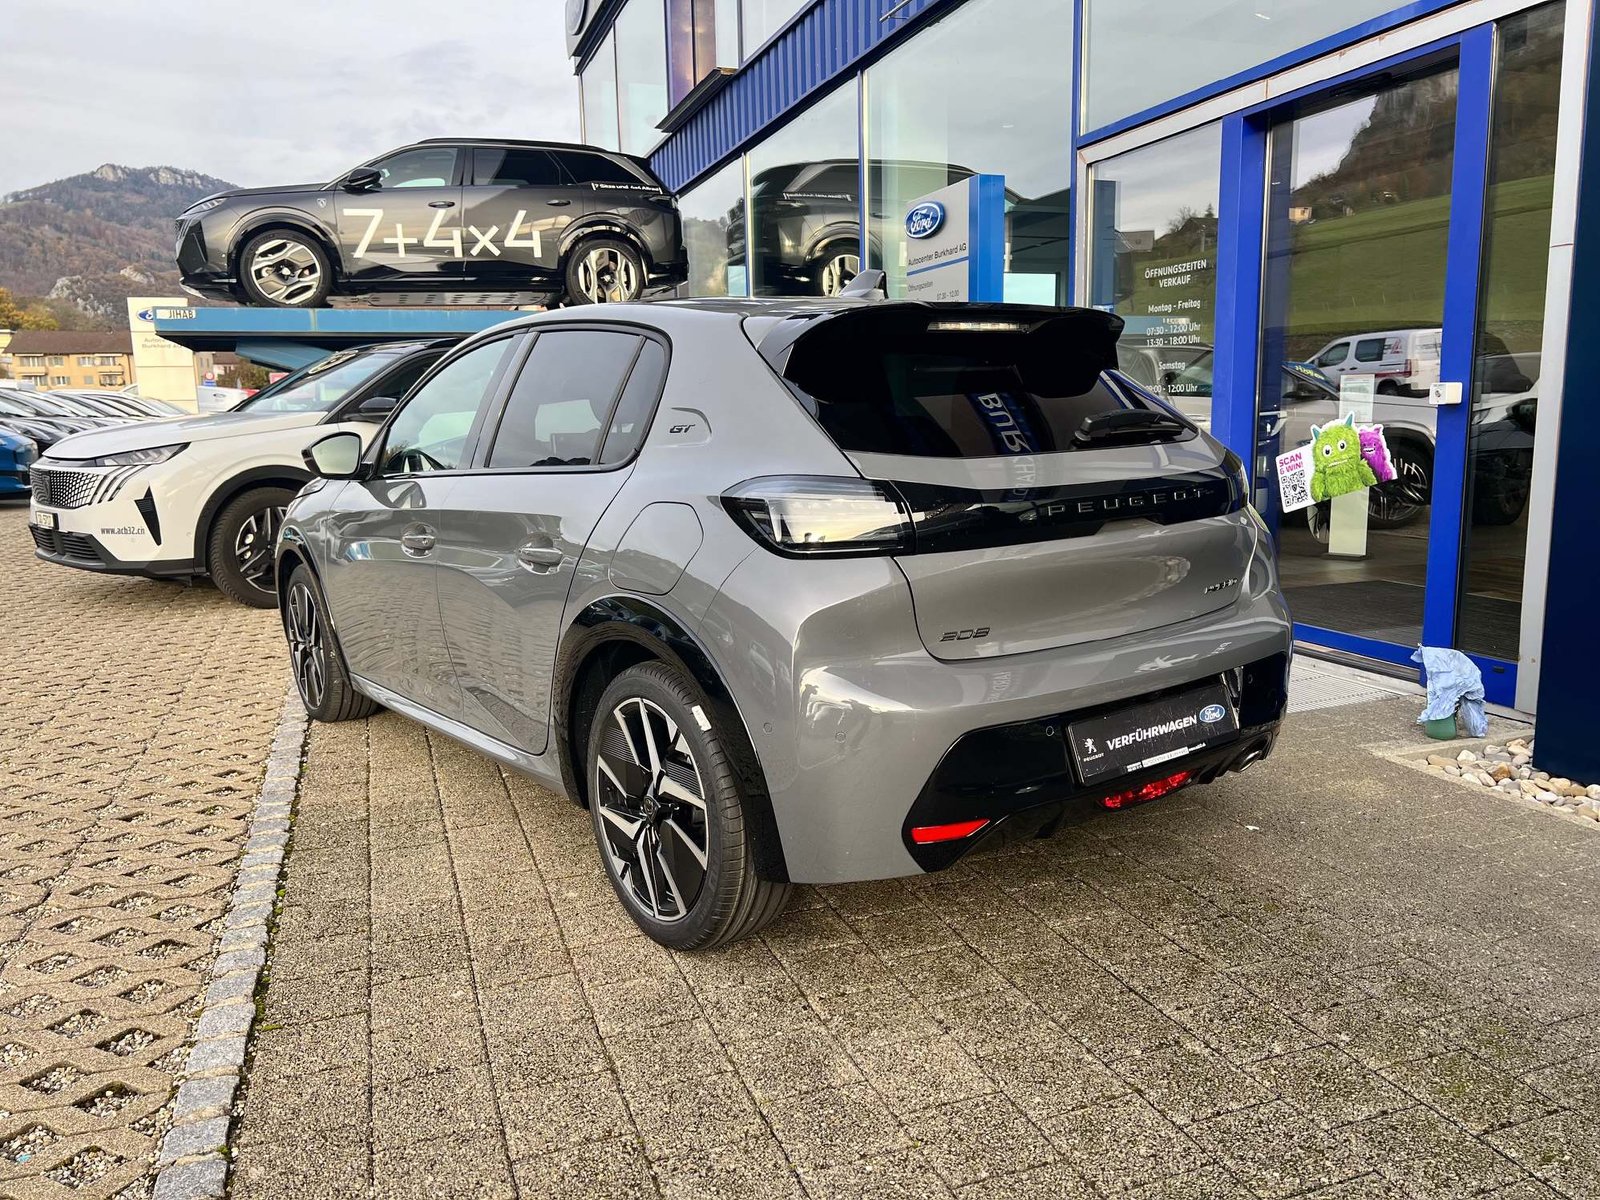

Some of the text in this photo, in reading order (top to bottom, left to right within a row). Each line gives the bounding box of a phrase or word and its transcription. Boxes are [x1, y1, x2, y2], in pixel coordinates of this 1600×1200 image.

[908, 242, 967, 266] Autocenter Burkhard AG
[1145, 259, 1207, 279] ÖFFNUNGSZEITEN
[1159, 275, 1191, 288] VERKAUF
[1148, 304, 1172, 313] Montag
[1178, 299, 1201, 309] Freitag
[1146, 327, 1164, 336] 07:30
[1189, 322, 1201, 331] Uhr
[1146, 338, 1163, 347] 13:30
[1169, 336, 1187, 345] 18:00
[1188, 335, 1200, 344] Uhr
[1158, 361, 1186, 370] Samstag
[1167, 384, 1184, 393] 12:00
[1185, 383, 1198, 392] Uhr
[670, 424, 696, 433] GT
[1279, 453, 1302, 467] SCAN
[1285, 462, 1304, 473] WIN!
[1048, 485, 1206, 516] PEUGEOT
[940, 627, 990, 642] 208
[1106, 714, 1197, 750] VERFÜHRWAGEN
